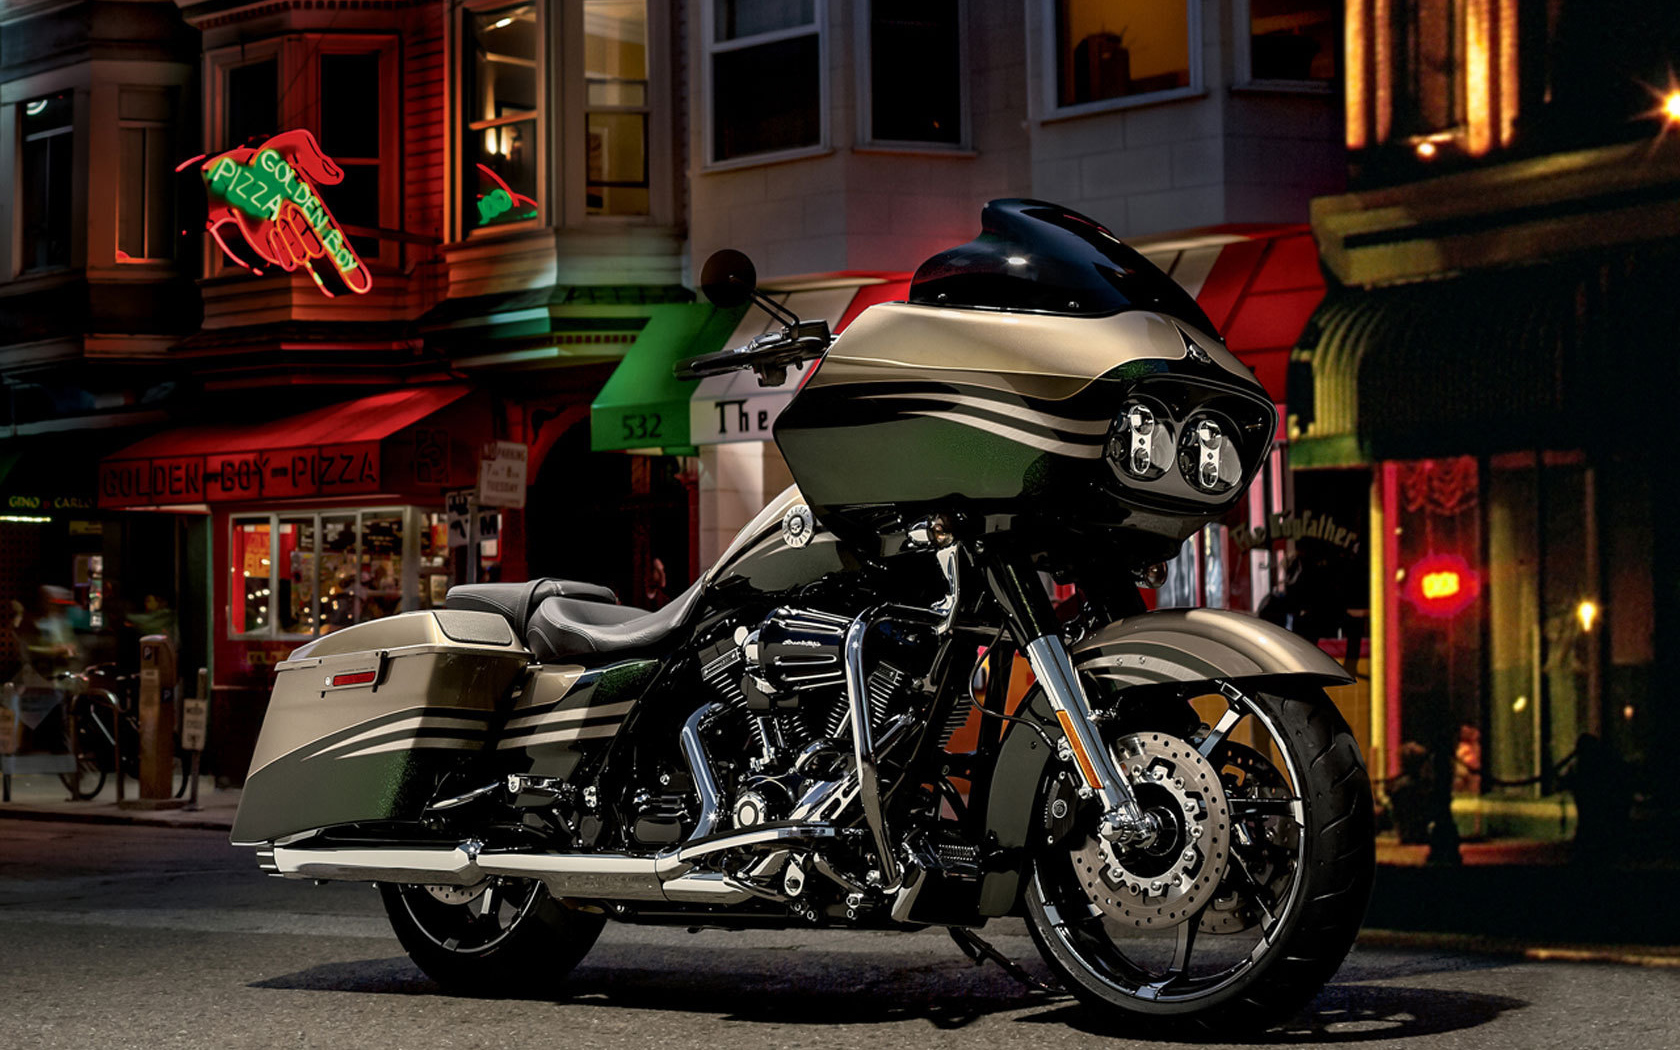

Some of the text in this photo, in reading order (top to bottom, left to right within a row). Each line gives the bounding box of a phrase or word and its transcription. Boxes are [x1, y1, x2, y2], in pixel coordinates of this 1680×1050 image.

[213, 157, 283, 222] PIZZA
[261, 150, 329, 232] GOLDEN
[622, 412, 663, 441] 532
[714, 398, 769, 434] The
